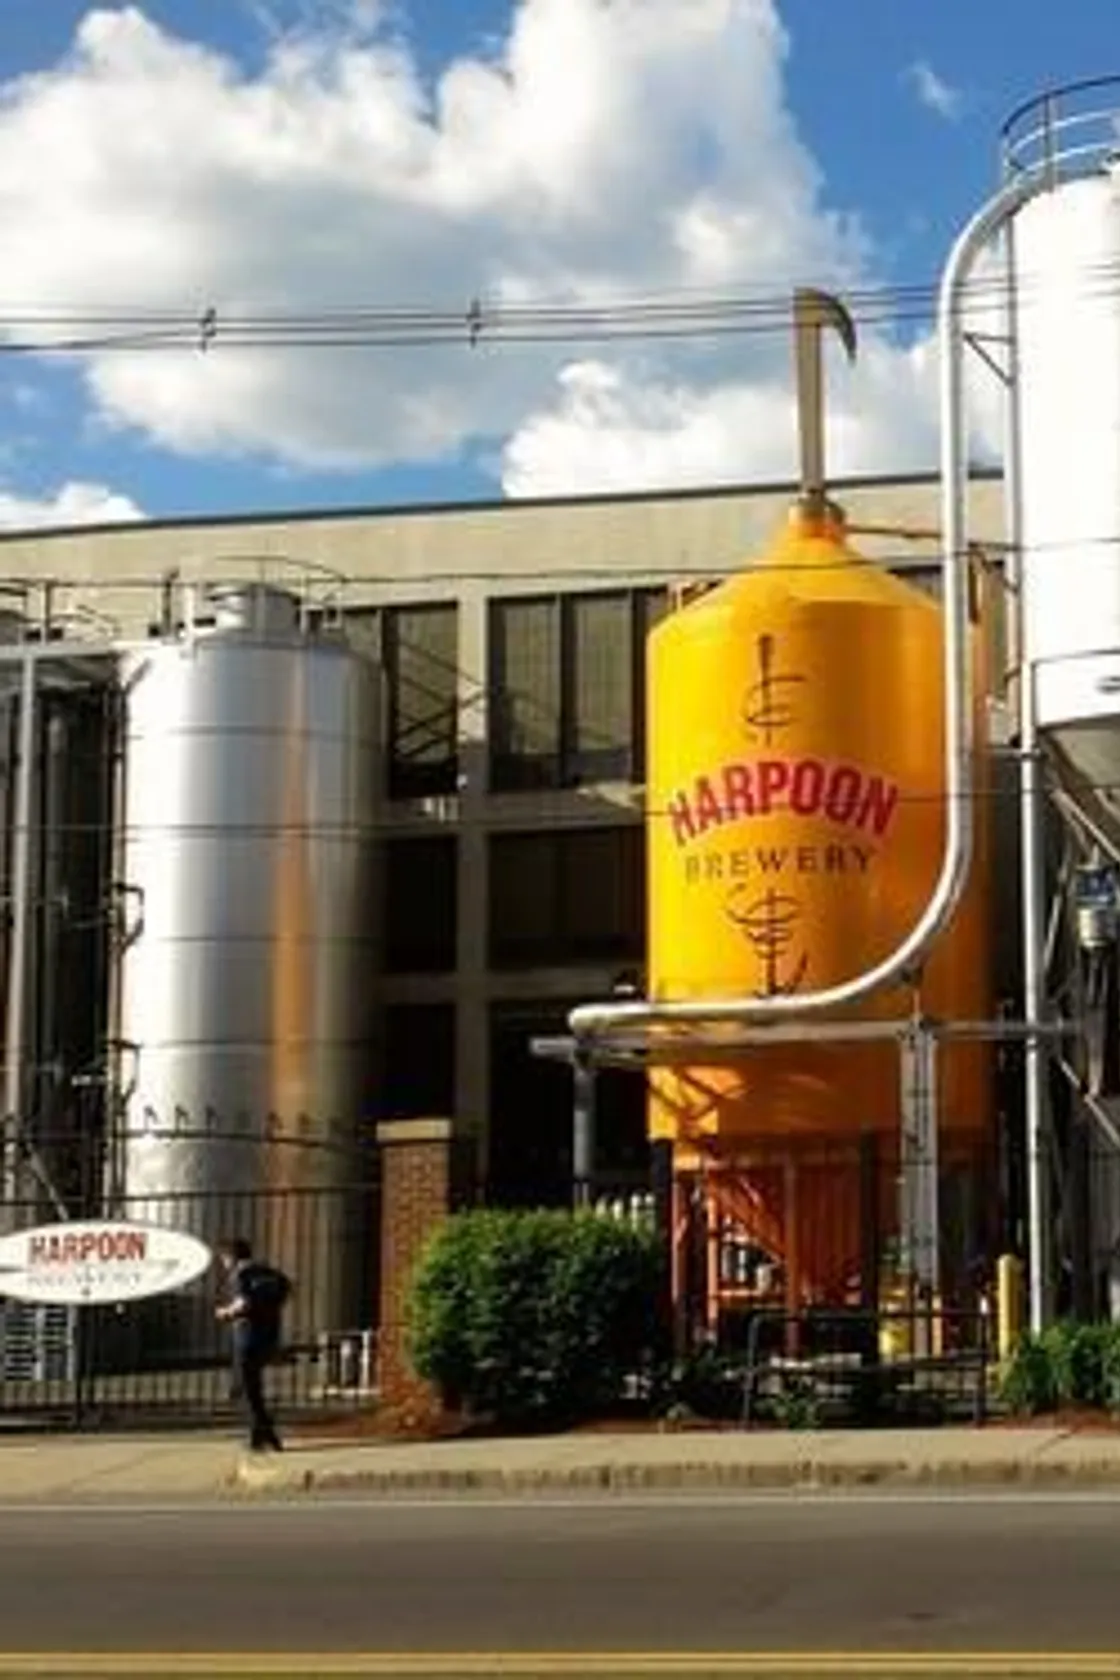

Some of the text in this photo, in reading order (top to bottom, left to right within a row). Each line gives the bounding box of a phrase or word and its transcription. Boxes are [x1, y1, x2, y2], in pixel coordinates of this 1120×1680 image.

[668, 760, 899, 847] HARPOON
[685, 845, 873, 883] BREWERY
[28, 1231, 147, 1264] HARPOON
